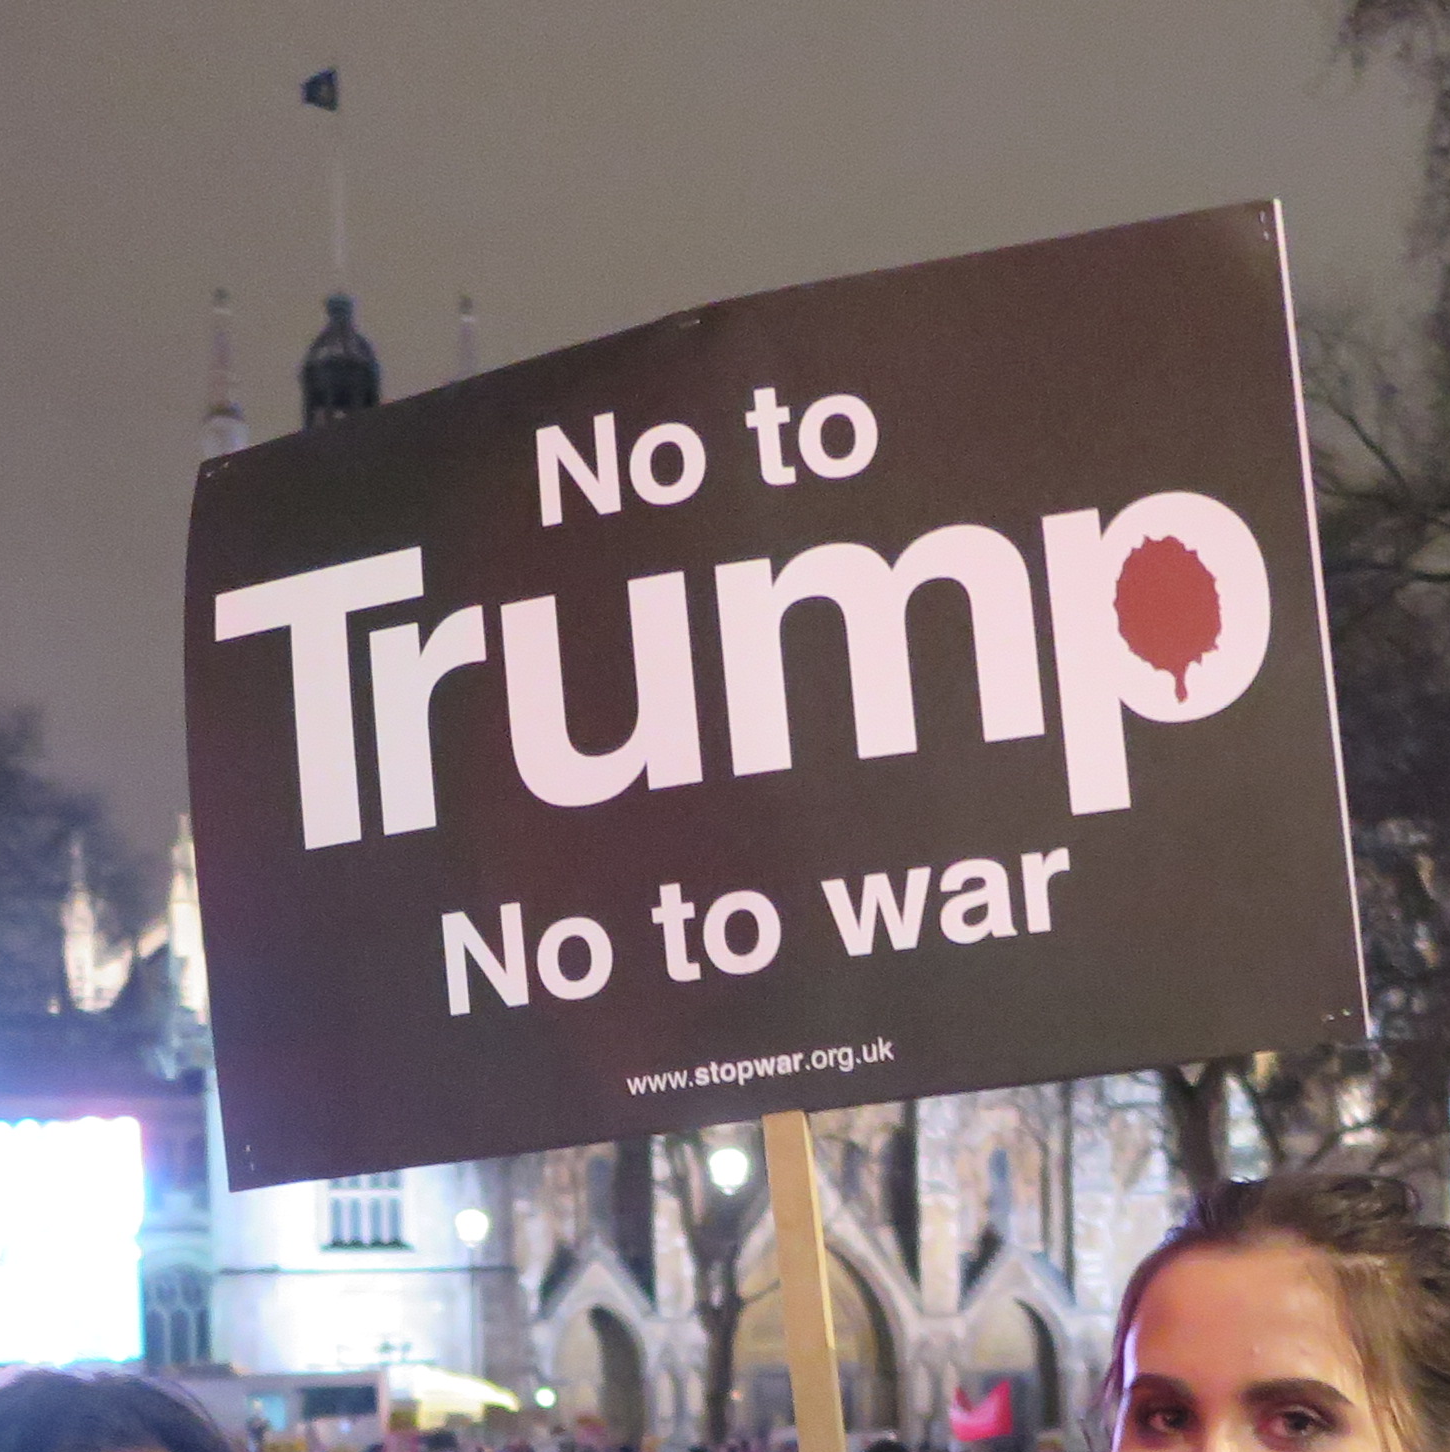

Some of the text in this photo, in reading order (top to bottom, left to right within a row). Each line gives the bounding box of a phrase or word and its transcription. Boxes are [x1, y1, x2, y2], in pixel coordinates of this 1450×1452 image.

[535, 387, 879, 528] No to
[214, 490, 1271, 850] Trump
[441, 847, 1071, 1015] No to war
[627, 1036, 894, 1096] www.stopwar.org.uk
